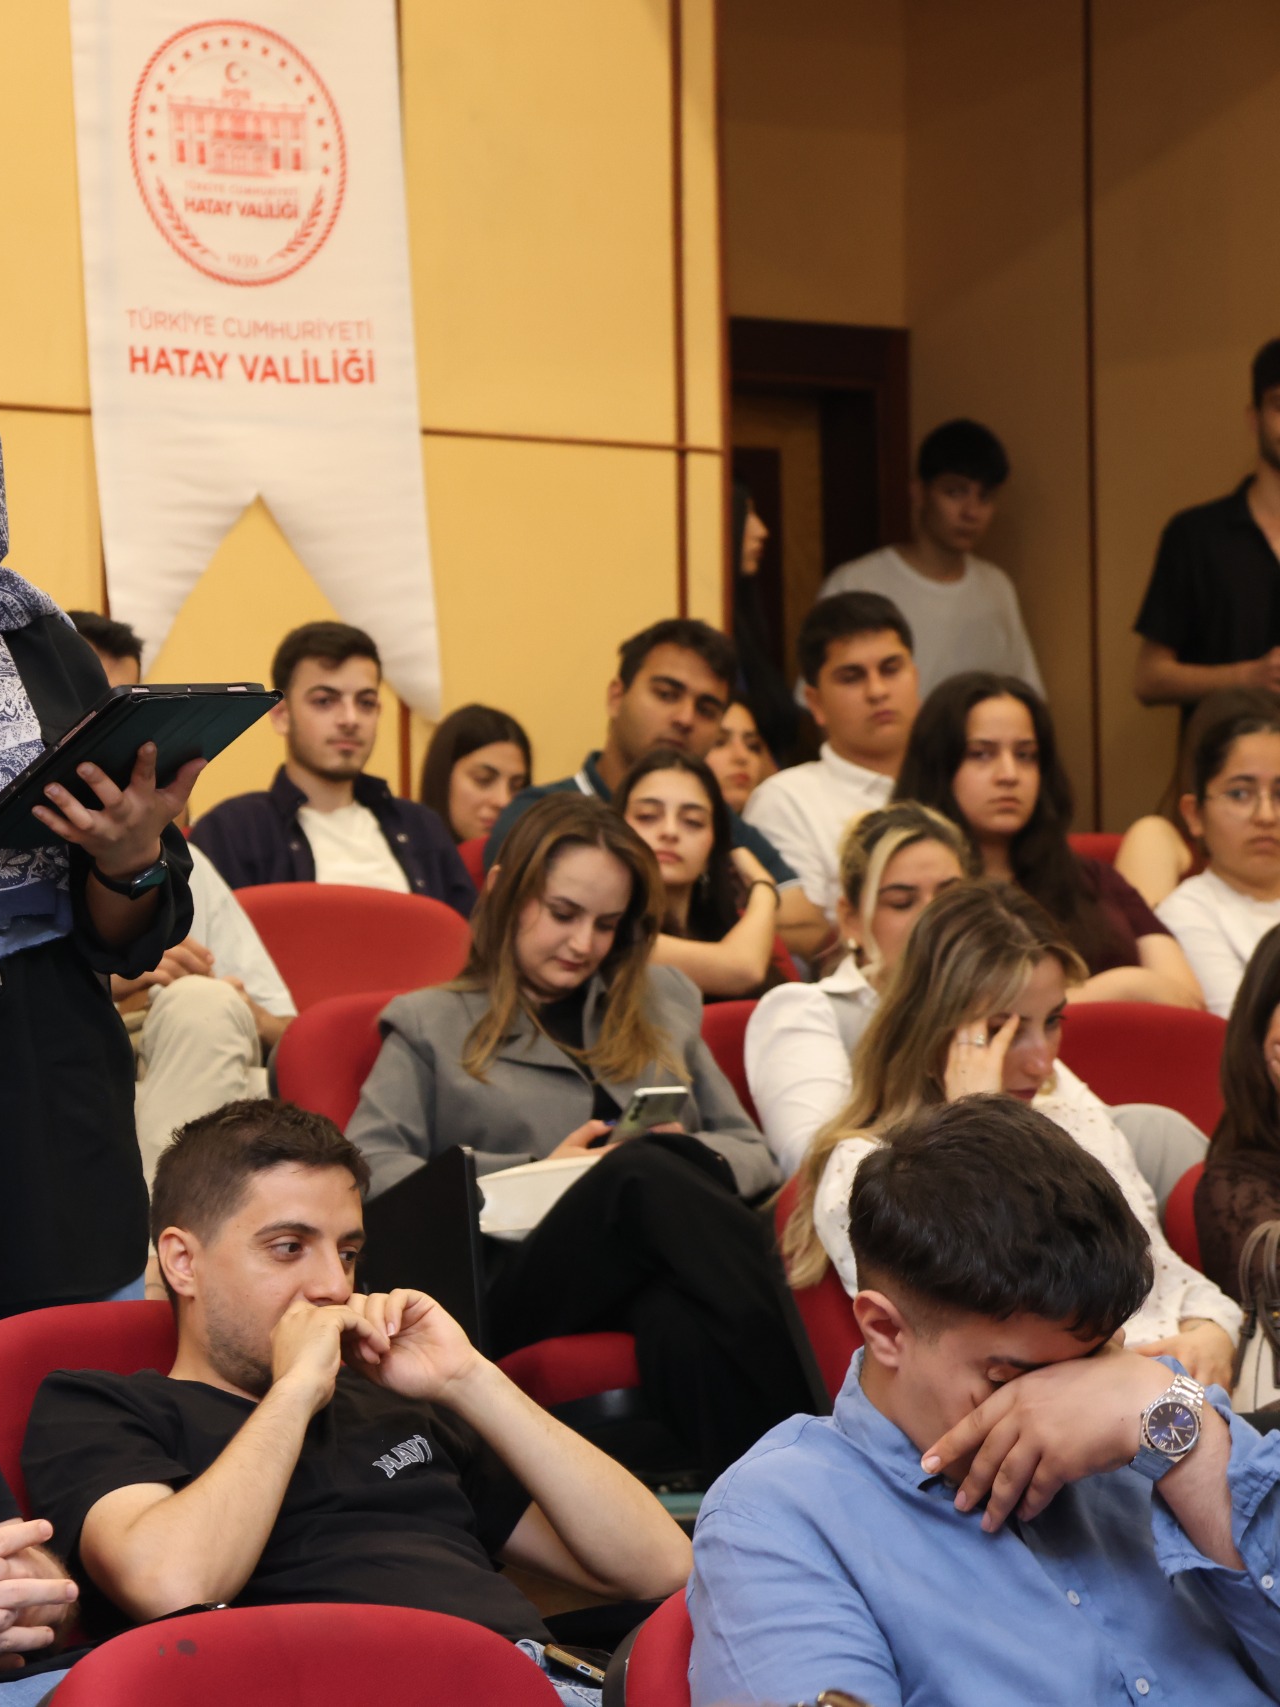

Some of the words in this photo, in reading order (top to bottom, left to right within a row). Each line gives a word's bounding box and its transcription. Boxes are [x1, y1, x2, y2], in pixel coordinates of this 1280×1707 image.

[183, 196, 232, 216] HATAY
[125, 307, 216, 337] TÜRKİYE
[222, 314, 374, 342] CUMHURİYETİ
[128, 345, 228, 381] HATAY
[238, 348, 375, 384] VALİLİĞİ
